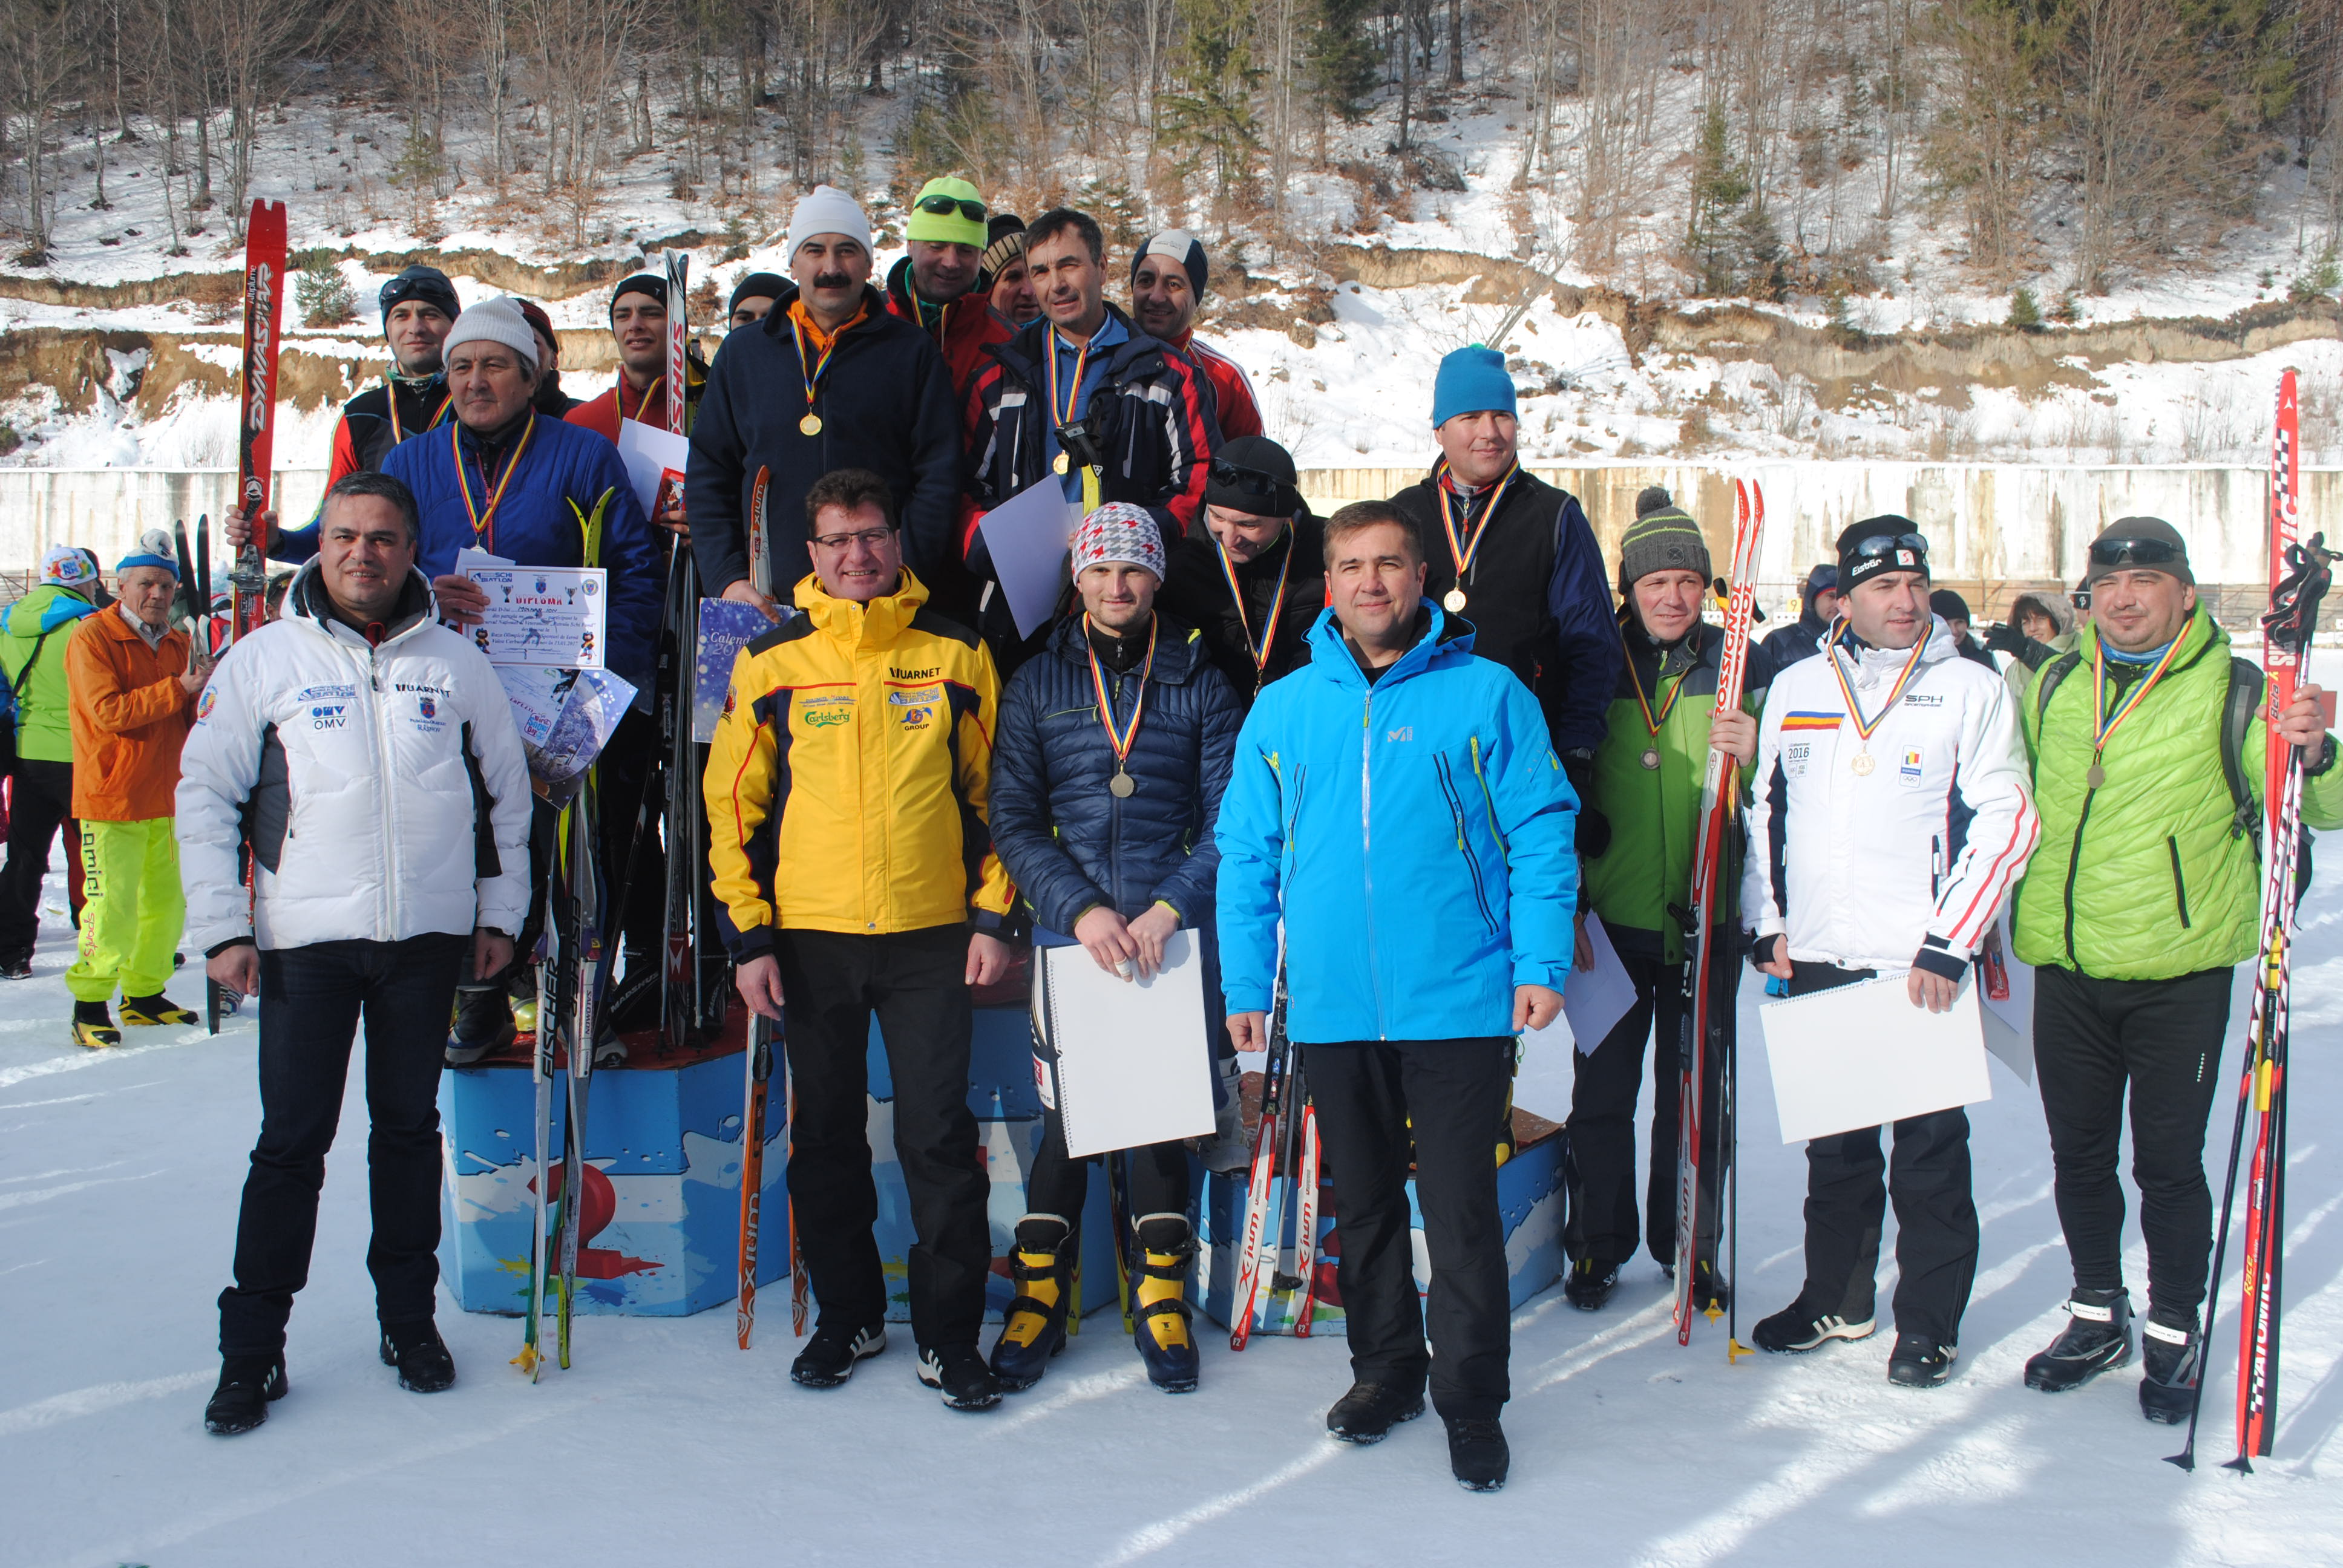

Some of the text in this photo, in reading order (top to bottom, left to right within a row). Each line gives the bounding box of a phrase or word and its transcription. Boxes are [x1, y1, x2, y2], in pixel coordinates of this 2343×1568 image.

[249, 261, 274, 431] DYNASTAR
[516, 594, 563, 606] DIPLOMA
[1791, 599, 1797, 611] 9
[711, 632, 754, 645] Calend
[1714, 582, 1743, 720] ROSSIGNOL
[889, 667, 941, 679] VUARNET
[1905, 694, 1944, 703] SPH
[314, 718, 346, 730] OMV
[804, 710, 851, 726] Carlsberg
[1788, 746, 1810, 759] 2016
[83, 832, 104, 897] amici
[83, 912, 98, 958] sports
[610, 972, 660, 1014] MADSHUS
[542, 956, 559, 1081] FISCHER
[2243, 1253, 2254, 1296] Race
